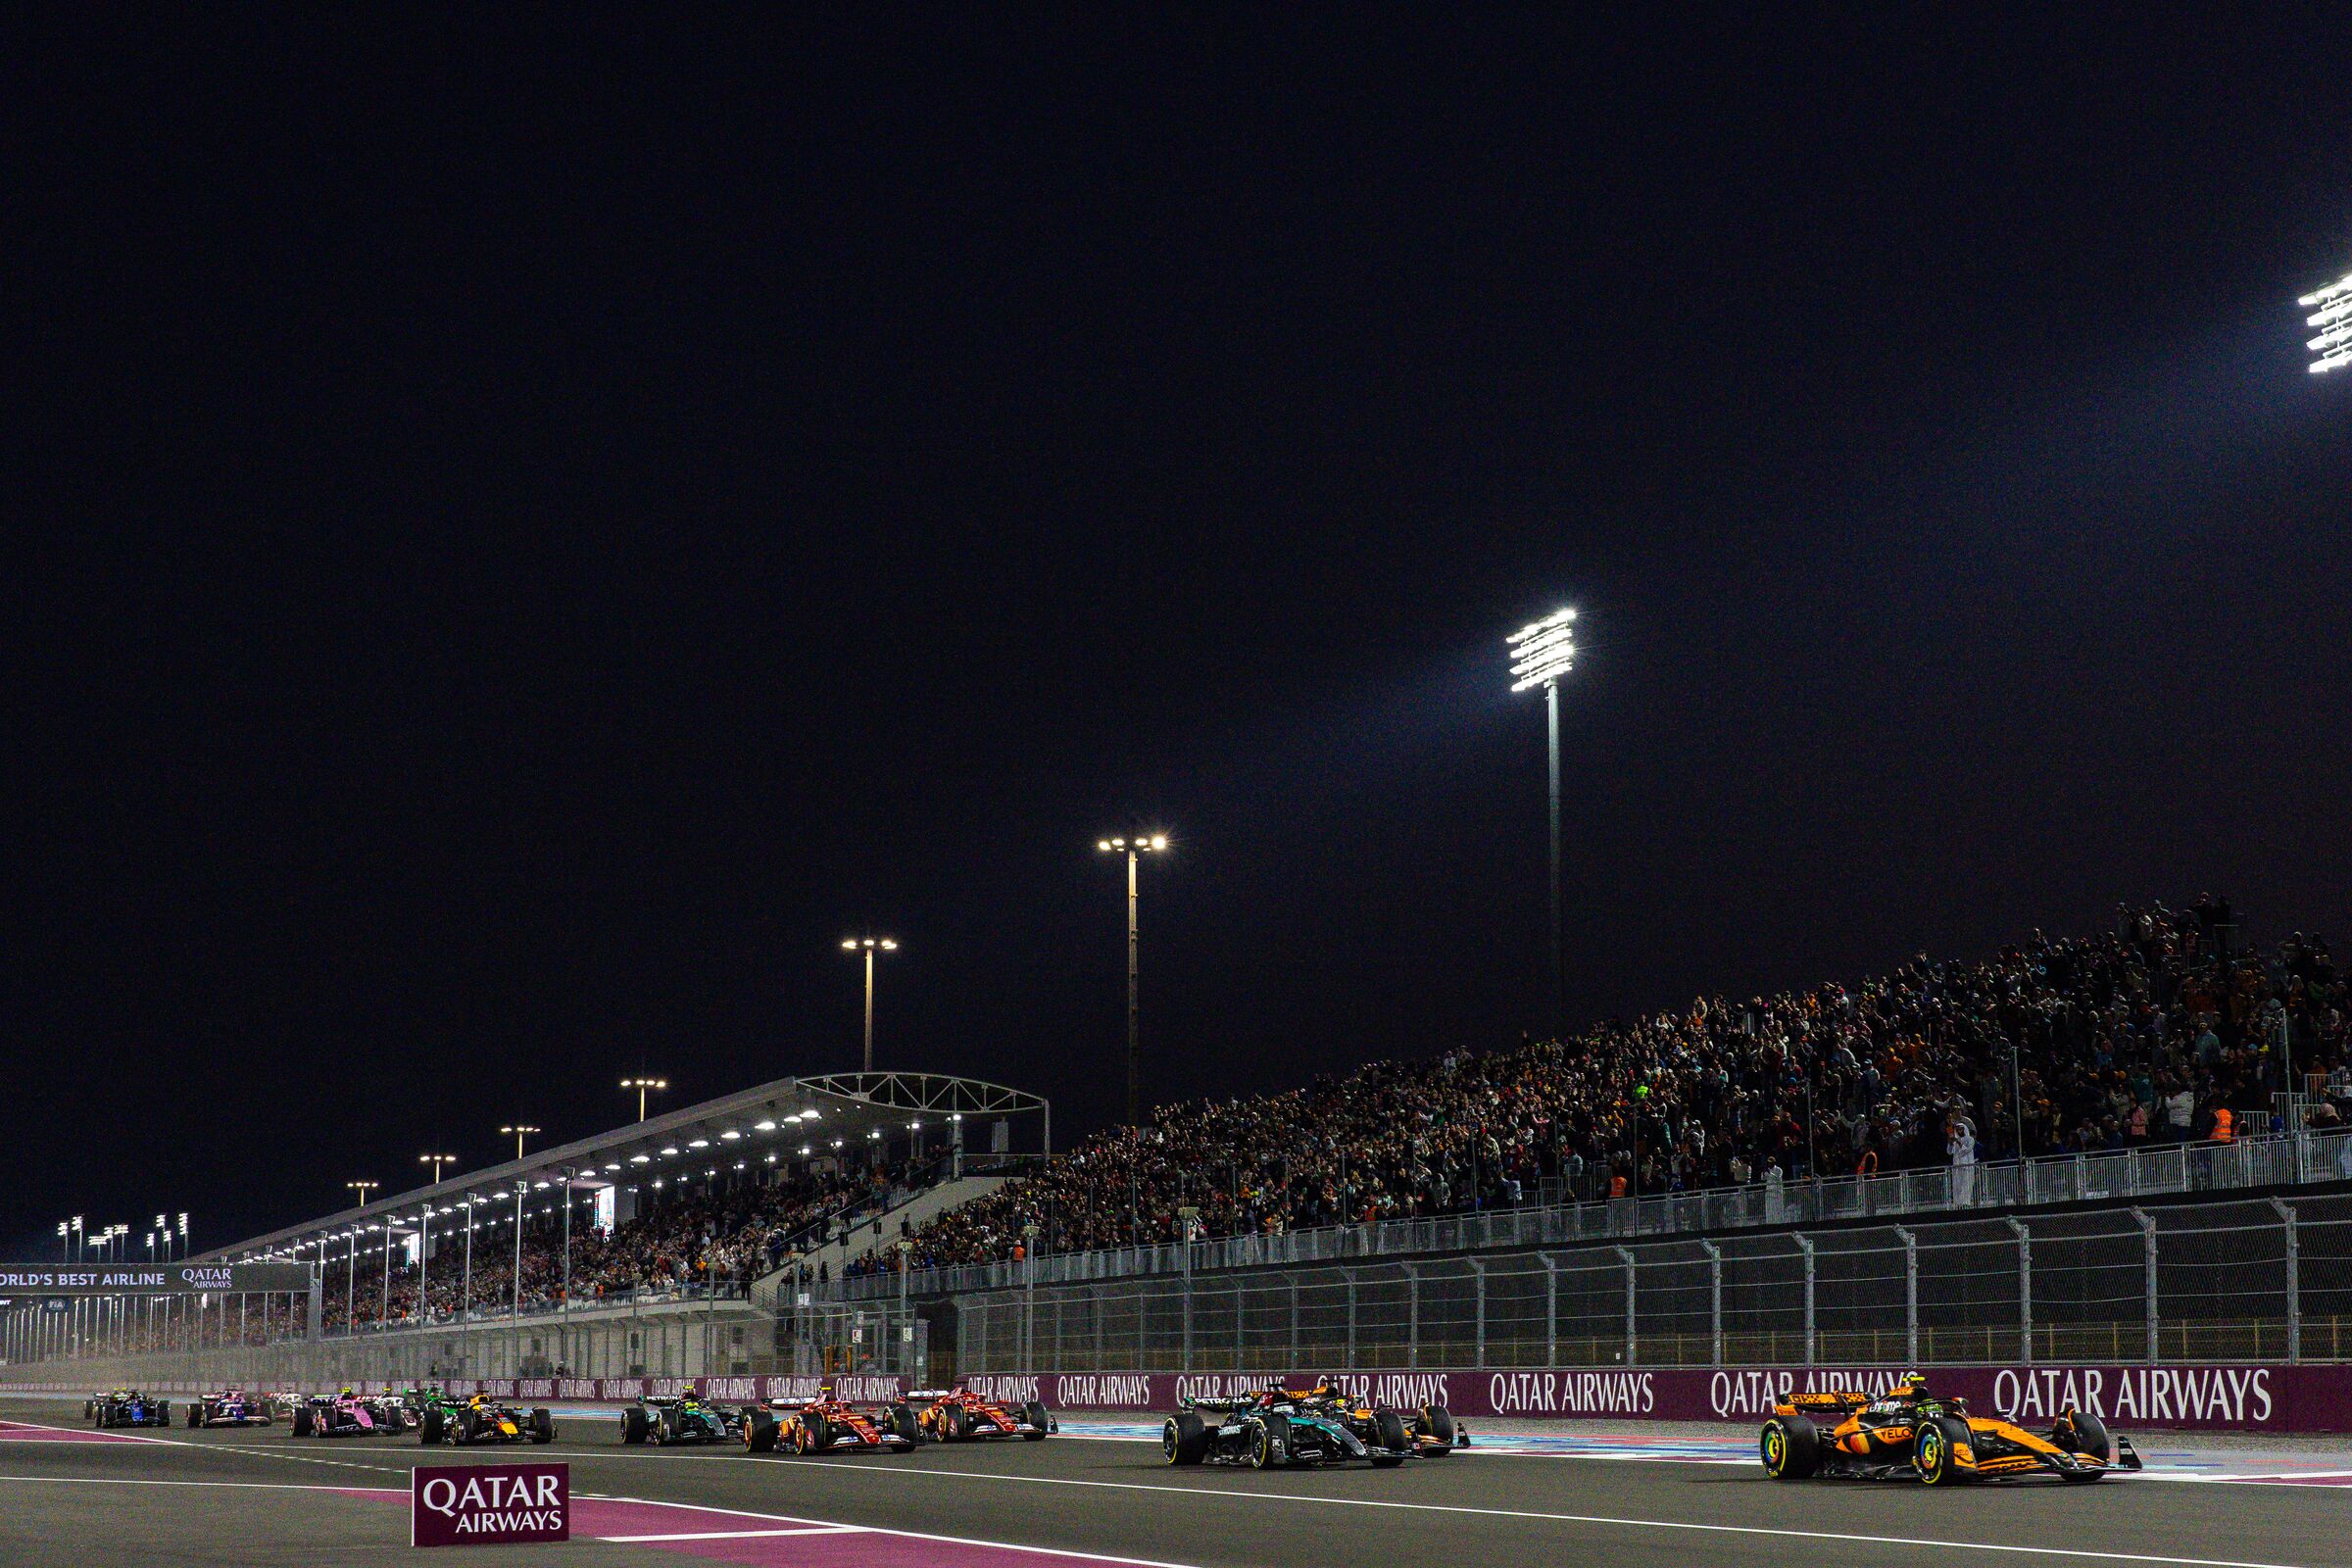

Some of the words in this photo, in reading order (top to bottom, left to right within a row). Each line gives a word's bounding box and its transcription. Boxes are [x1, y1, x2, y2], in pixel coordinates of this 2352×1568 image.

[58, 1273, 97, 1286] BEST
[102, 1273, 166, 1286] AIRLINE
[182, 1268, 231, 1281] QATAR
[193, 1280, 232, 1289] AIRWAYS
[49, 1301, 64, 1310] FIA
[707, 1378, 727, 1399] QATAR
[728, 1378, 756, 1399] AIRWAYS
[767, 1377, 791, 1398] QATAR
[835, 1377, 862, 1401] QATAR
[863, 1377, 900, 1402] AIRWAYS
[996, 1376, 1039, 1403] AIRWAYS
[1057, 1375, 1096, 1406] QATAR
[1099, 1375, 1150, 1404] AIRWAYS
[1176, 1375, 1221, 1405] QATAR
[1374, 1374, 1448, 1409] AIRWAYS
[1490, 1373, 1556, 1414] QATAR
[1561, 1372, 1654, 1413] AIRWAYS
[1993, 1369, 2106, 1423] QATAR
[2114, 1368, 2273, 1421] AIRWAYS
[1882, 1428, 1911, 1439] VELO
[422, 1475, 562, 1517] QATAR
[455, 1510, 563, 1533] AIRWAYS
